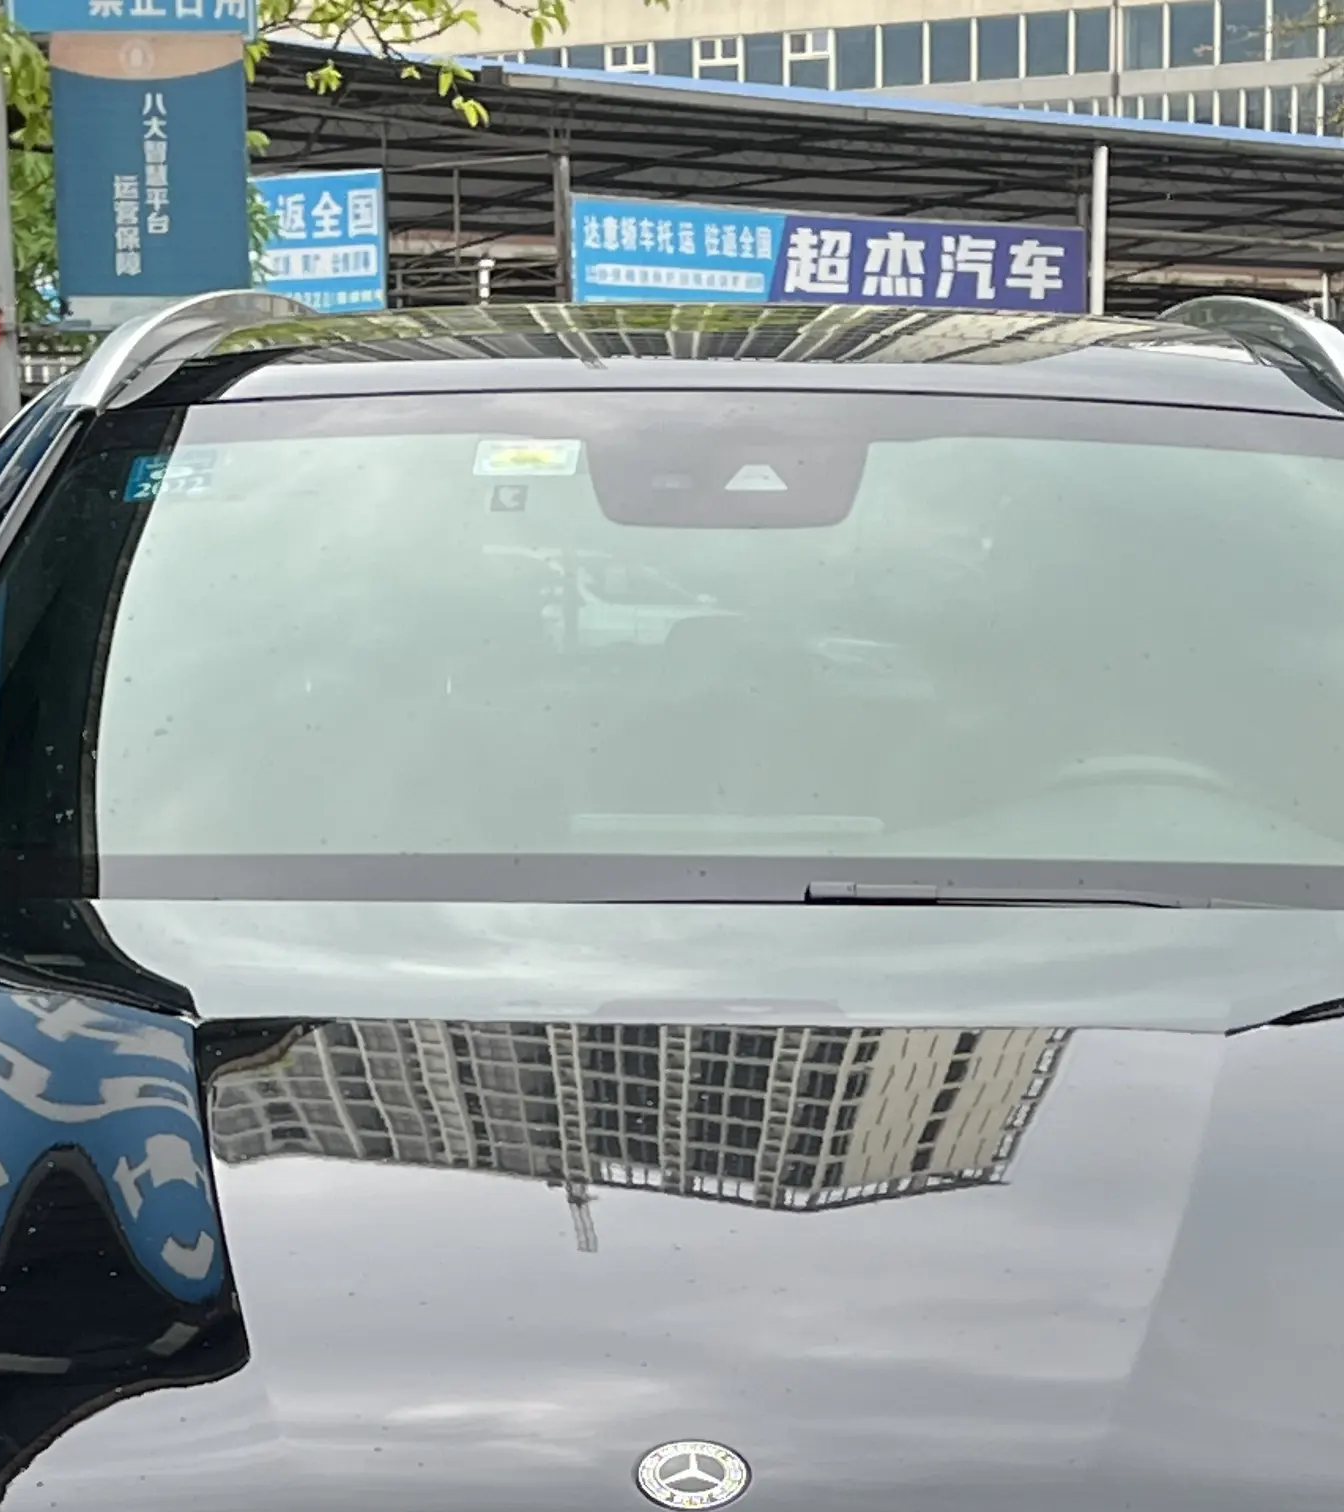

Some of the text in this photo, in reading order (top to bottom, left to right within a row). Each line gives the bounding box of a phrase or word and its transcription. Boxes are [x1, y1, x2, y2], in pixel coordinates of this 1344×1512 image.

[142, 92, 170, 234] 八大智慧平台
[256, 189, 378, 238] 返全国
[784, 227, 1065, 300] 超杰汽车
